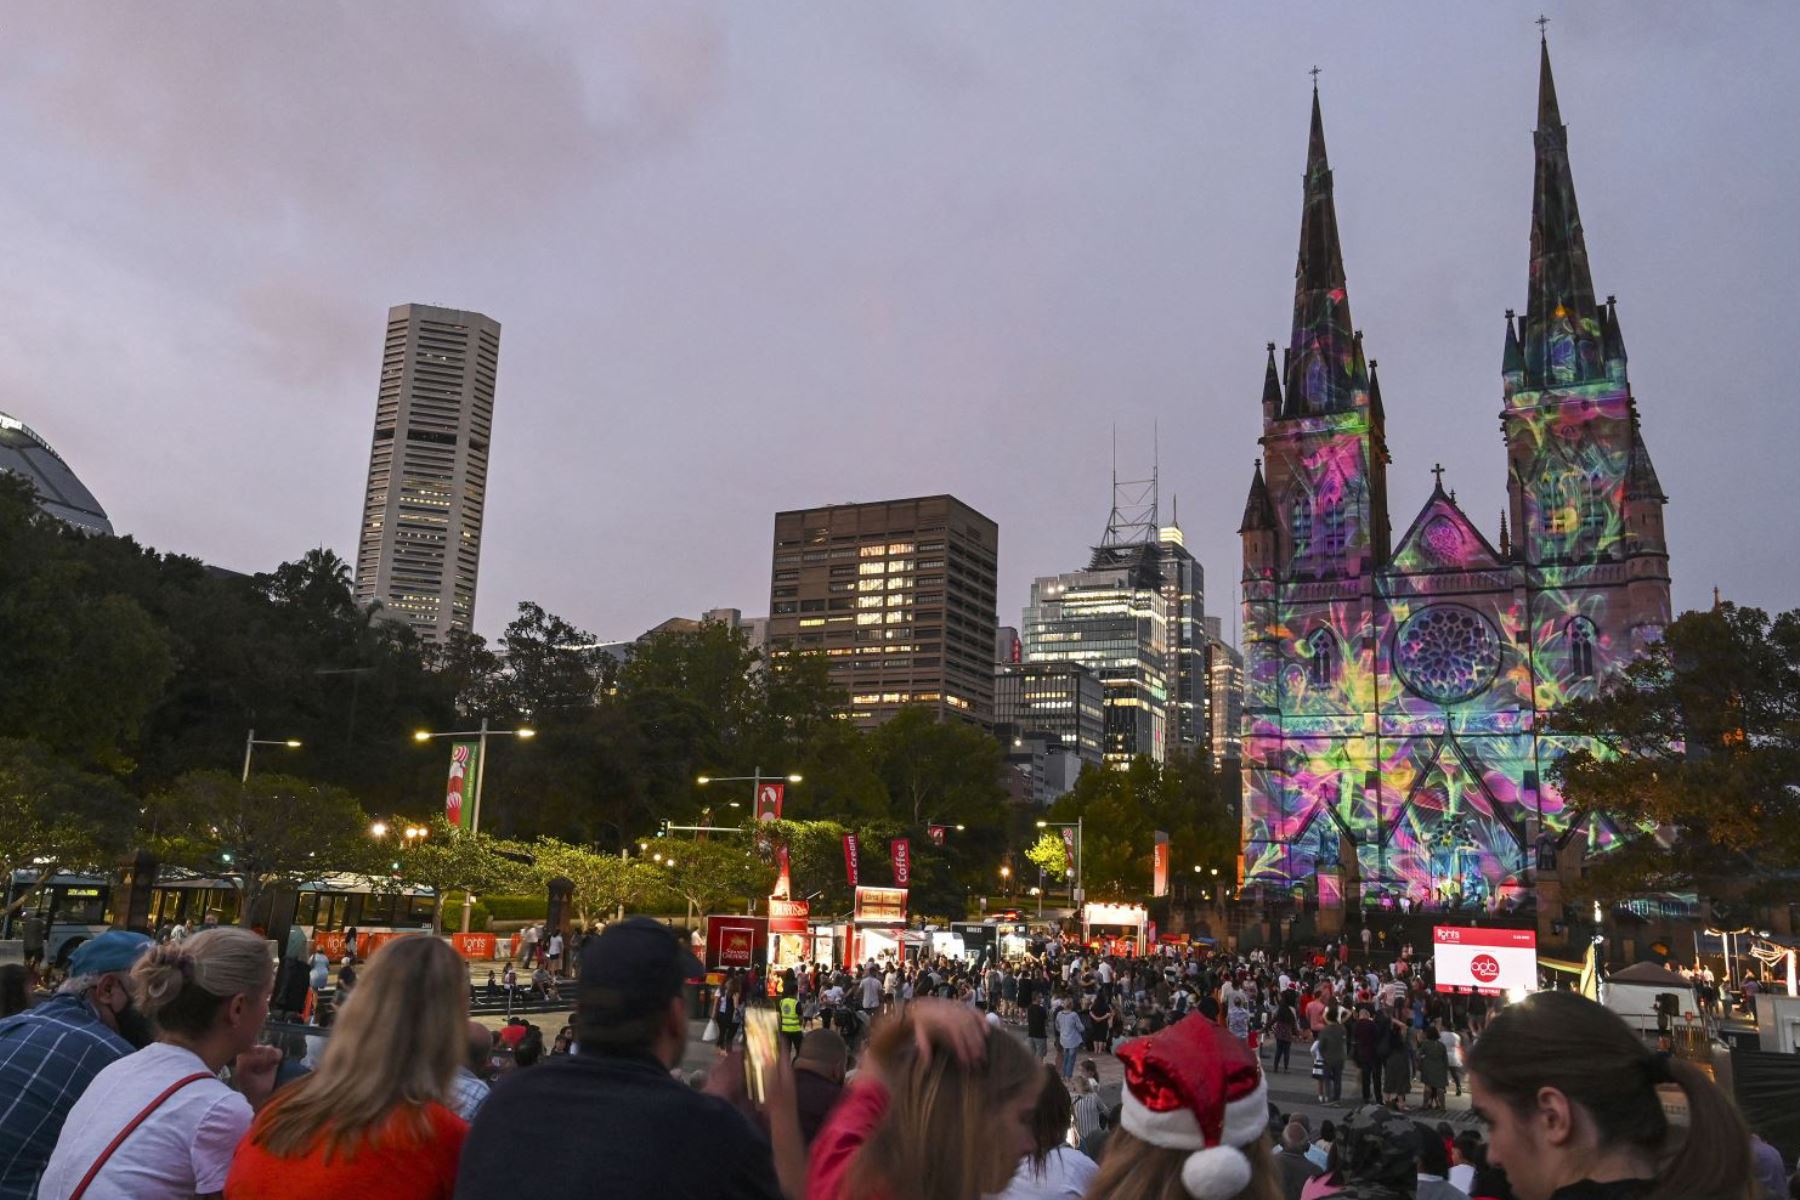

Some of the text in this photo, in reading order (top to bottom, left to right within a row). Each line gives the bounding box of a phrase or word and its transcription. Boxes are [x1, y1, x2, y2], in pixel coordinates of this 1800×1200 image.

[848, 835, 857, 868] Cream
[895, 844, 907, 882] Coffee
[463, 936, 486, 952] lights
[1437, 928, 1459, 941] lights
